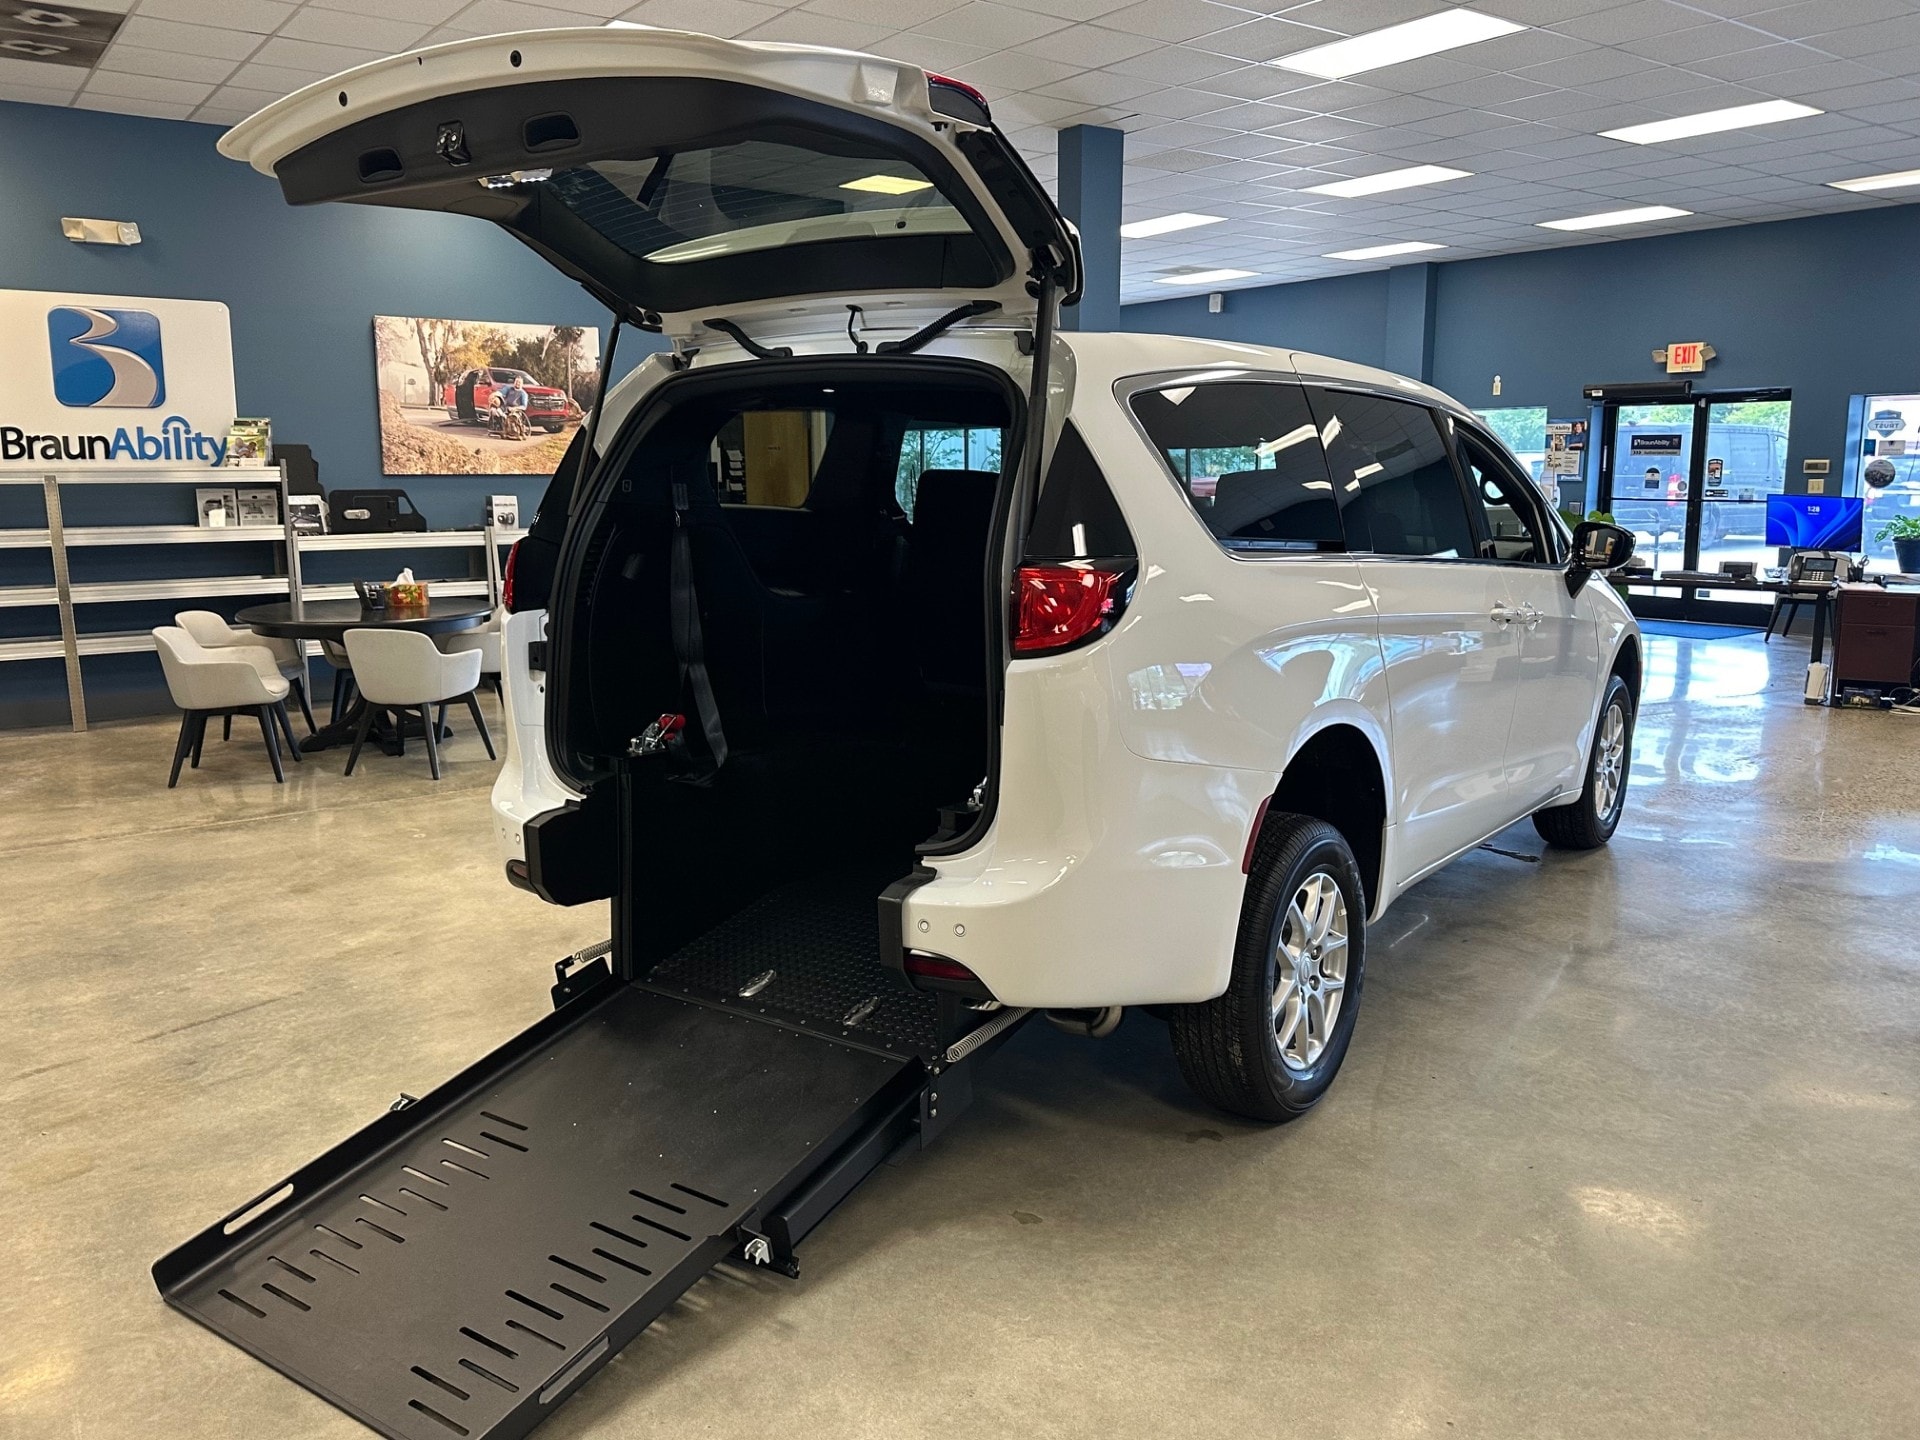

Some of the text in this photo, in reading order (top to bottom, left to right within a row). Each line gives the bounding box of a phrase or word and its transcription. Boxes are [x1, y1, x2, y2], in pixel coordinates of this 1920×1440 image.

[1674, 346, 1697, 364] EXIT
[0, 415, 228, 467] BraunAbility
[1640, 439, 1670, 447] BraunAbility
